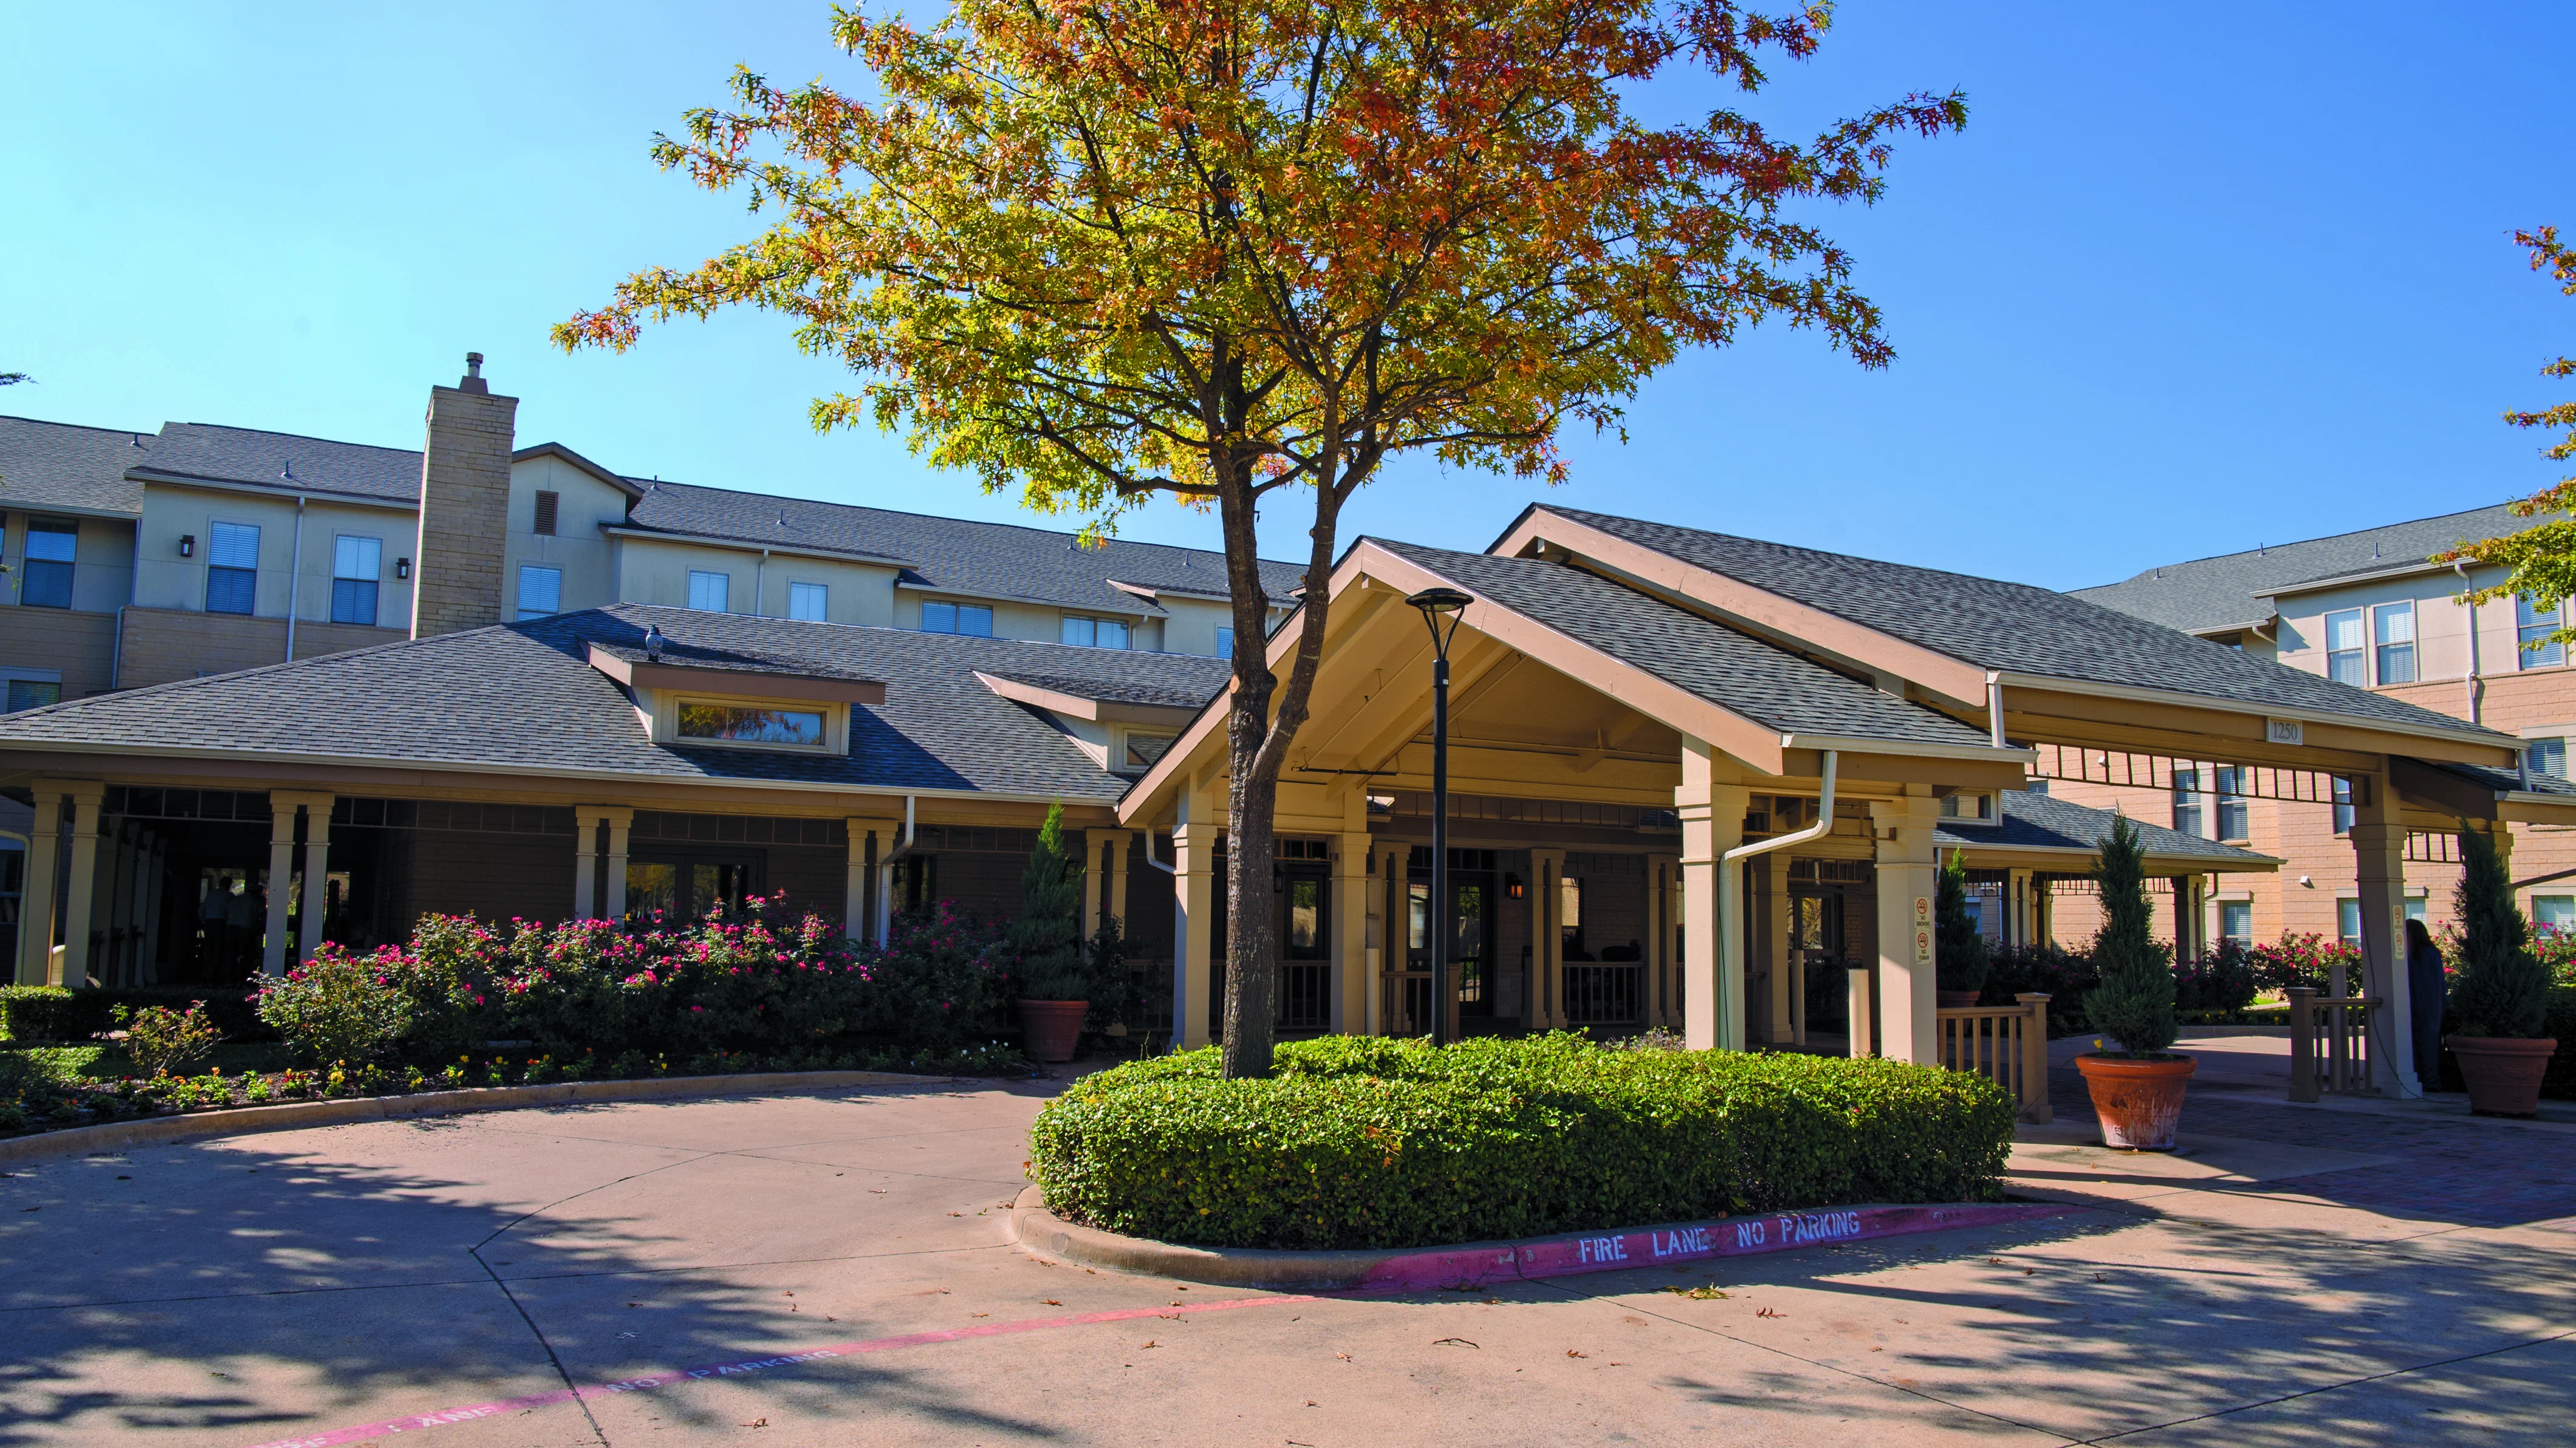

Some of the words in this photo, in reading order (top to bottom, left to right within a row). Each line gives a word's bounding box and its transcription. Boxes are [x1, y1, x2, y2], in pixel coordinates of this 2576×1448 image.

[2273, 722, 2298, 740] 1250
[1580, 1235, 1627, 1263] FIRE
[1653, 1228, 1709, 1257] LANE
[1737, 1222, 1764, 1247] NO
[1780, 1212, 1860, 1243] PARKING
[606, 1379, 660, 1392] NO
[687, 1350, 838, 1379] PARKING
